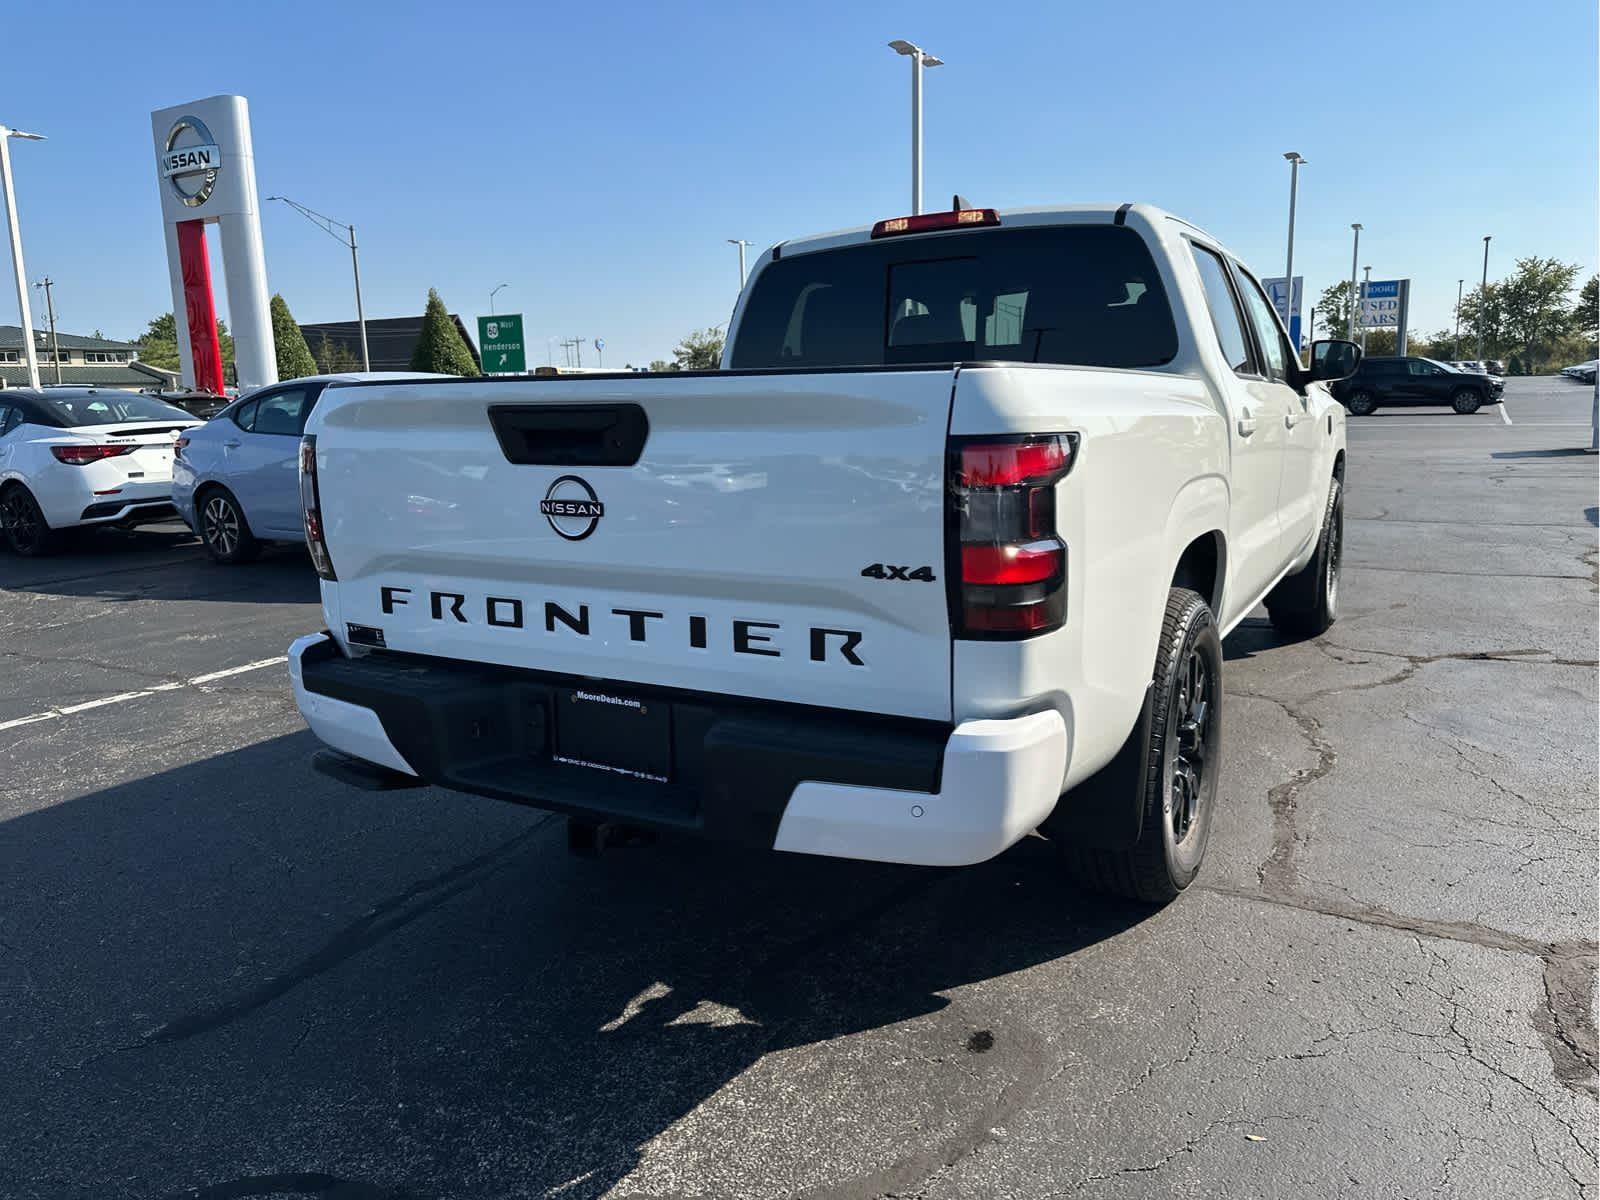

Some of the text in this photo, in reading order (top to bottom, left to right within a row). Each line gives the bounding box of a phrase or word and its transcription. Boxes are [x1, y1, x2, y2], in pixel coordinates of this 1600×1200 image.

[163, 150, 211, 171] NISSAN
[483, 343, 520, 351] Henderson
[541, 502, 601, 515] NISSAN
[381, 586, 864, 666] FRONTIER
[576, 690, 641, 708] MooreDeals.com
